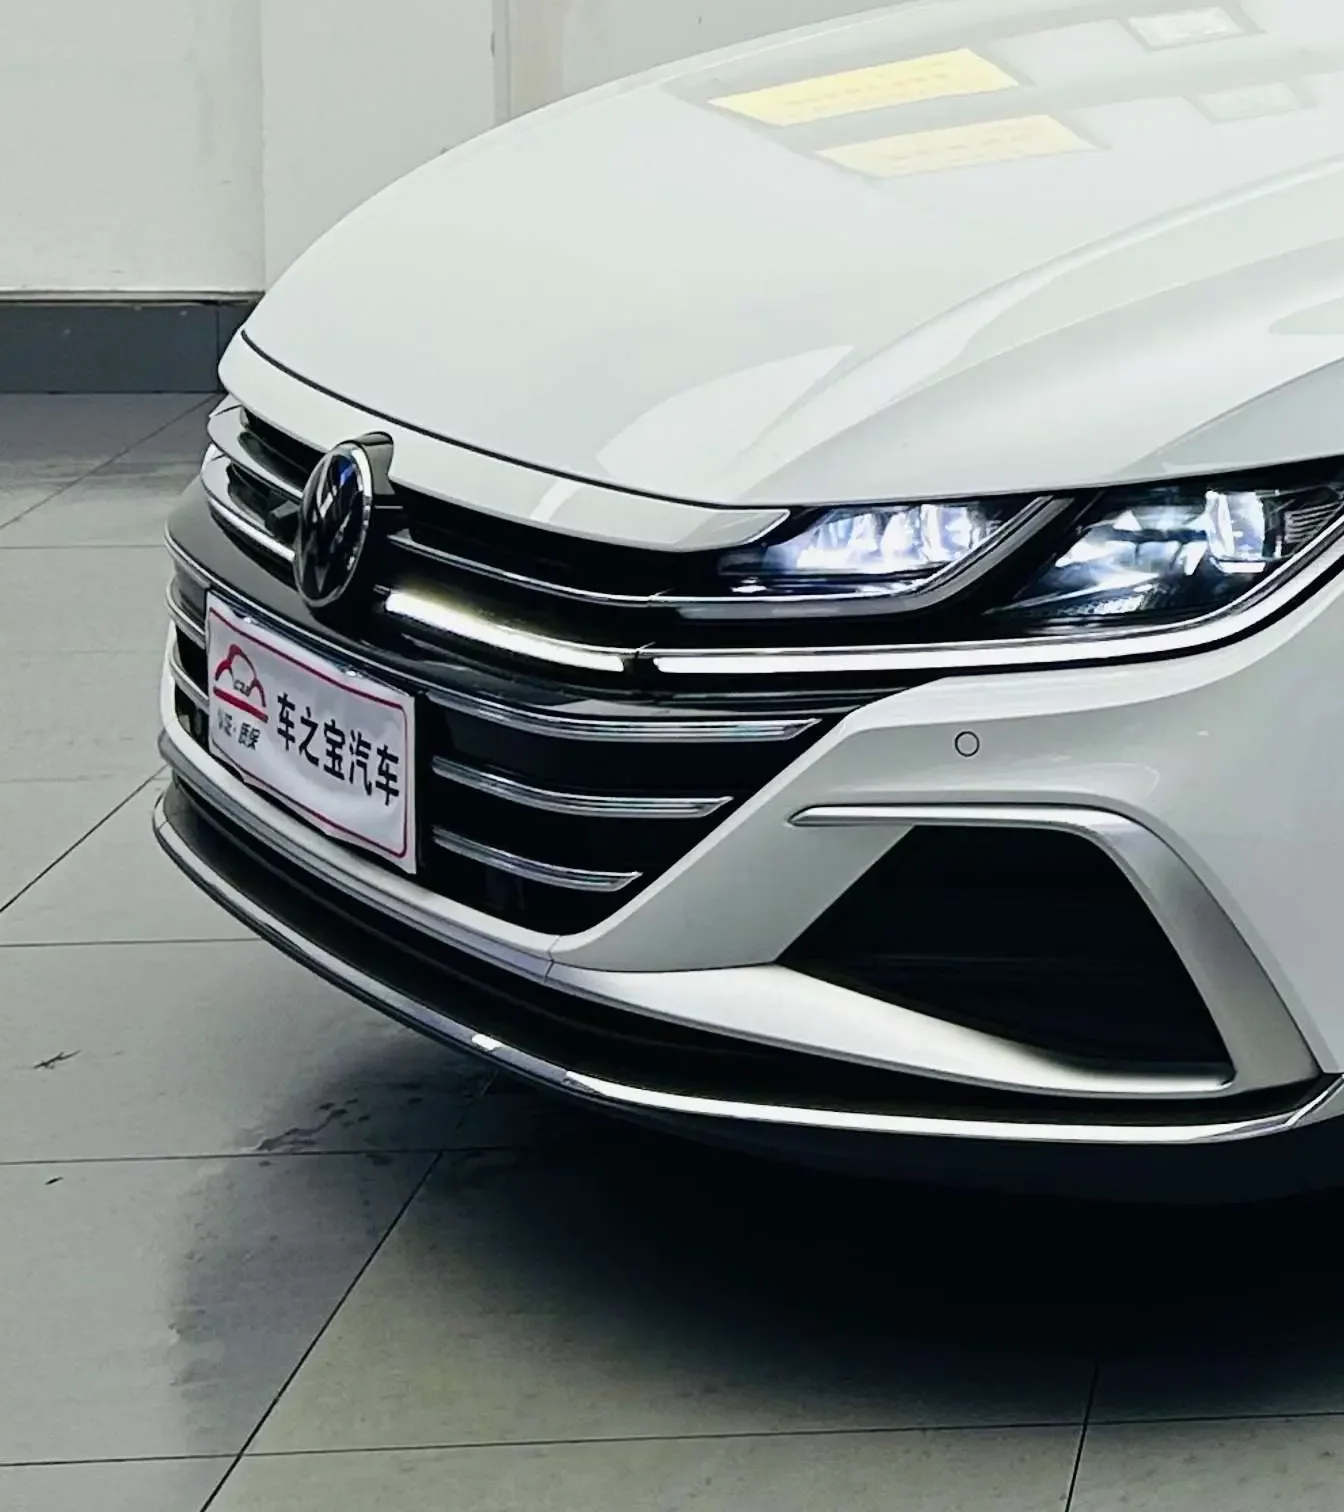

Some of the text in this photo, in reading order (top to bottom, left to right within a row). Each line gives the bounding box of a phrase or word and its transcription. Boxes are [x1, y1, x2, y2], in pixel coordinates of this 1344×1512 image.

[277, 692, 400, 807] 车之宝汽车
